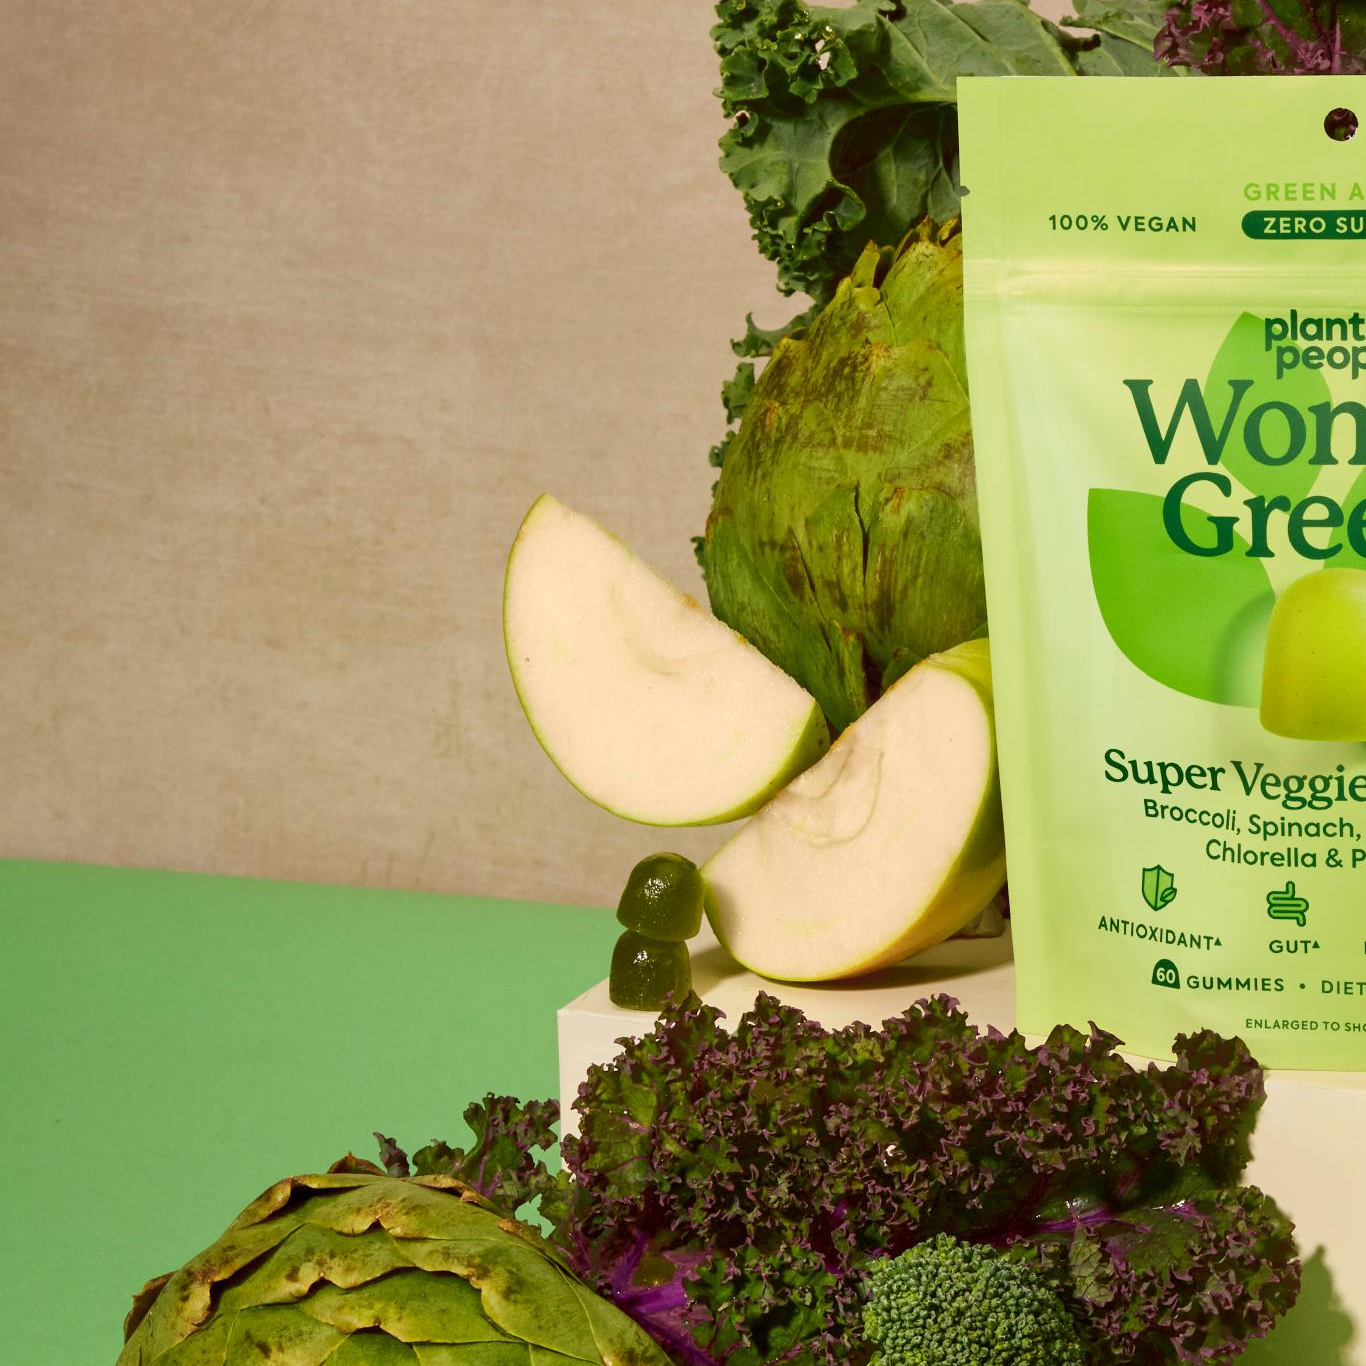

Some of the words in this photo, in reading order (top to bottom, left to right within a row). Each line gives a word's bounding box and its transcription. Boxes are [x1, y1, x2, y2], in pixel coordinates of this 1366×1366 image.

[1243, 183, 1336, 202] GREEN
[1049, 214, 1109, 231] 100%
[1117, 216, 1197, 233] VEGAN
[1263, 216, 1328, 234] ZERO
[1264, 309, 1366, 351] plant
[1104, 748, 1225, 795] Super
[1143, 799, 1242, 834] Broccoli,
[1248, 814, 1361, 841] Spinach,
[1205, 839, 1317, 868] Chlorella
[1324, 847, 1343, 868] &
[1098, 916, 1213, 950] ANTIOXIDANT
[1269, 940, 1311, 954] GUT
[1156, 966, 1175, 984] 60
[1187, 974, 1285, 993] GUMMIES
[1245, 1019, 1318, 1032] ENLARGED
[1323, 1021, 1340, 1032] TO
